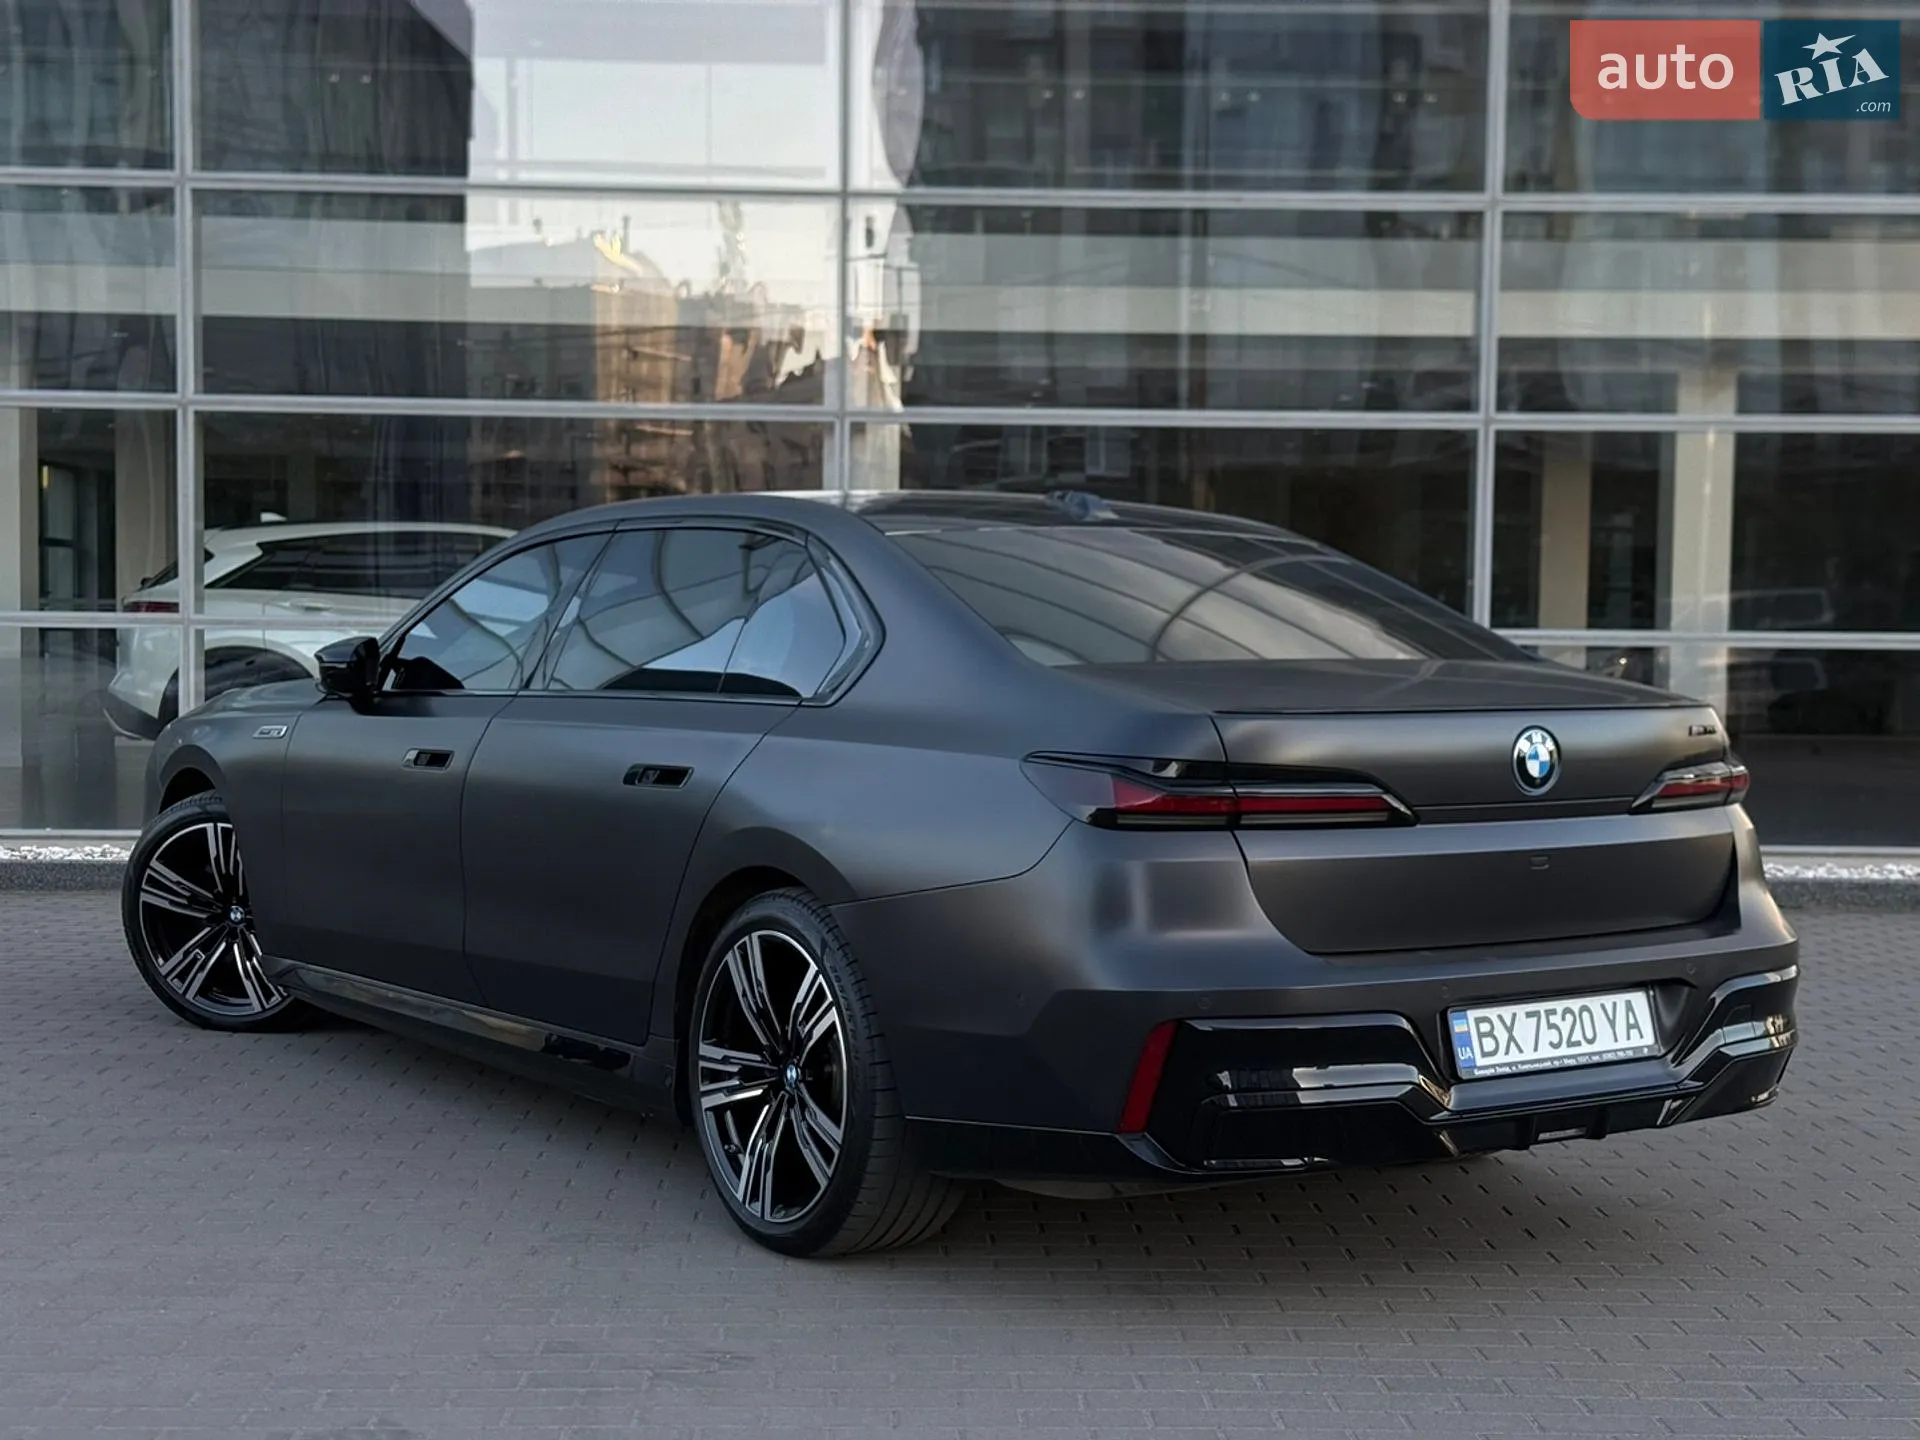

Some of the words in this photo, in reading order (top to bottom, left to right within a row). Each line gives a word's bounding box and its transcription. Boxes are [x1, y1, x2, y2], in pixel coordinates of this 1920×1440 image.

[1474, 1012, 1524, 1059] BX
[1525, 1004, 1597, 1052] 7520
[1600, 999, 1645, 1043] YA
[1458, 1046, 1474, 1060] UA
